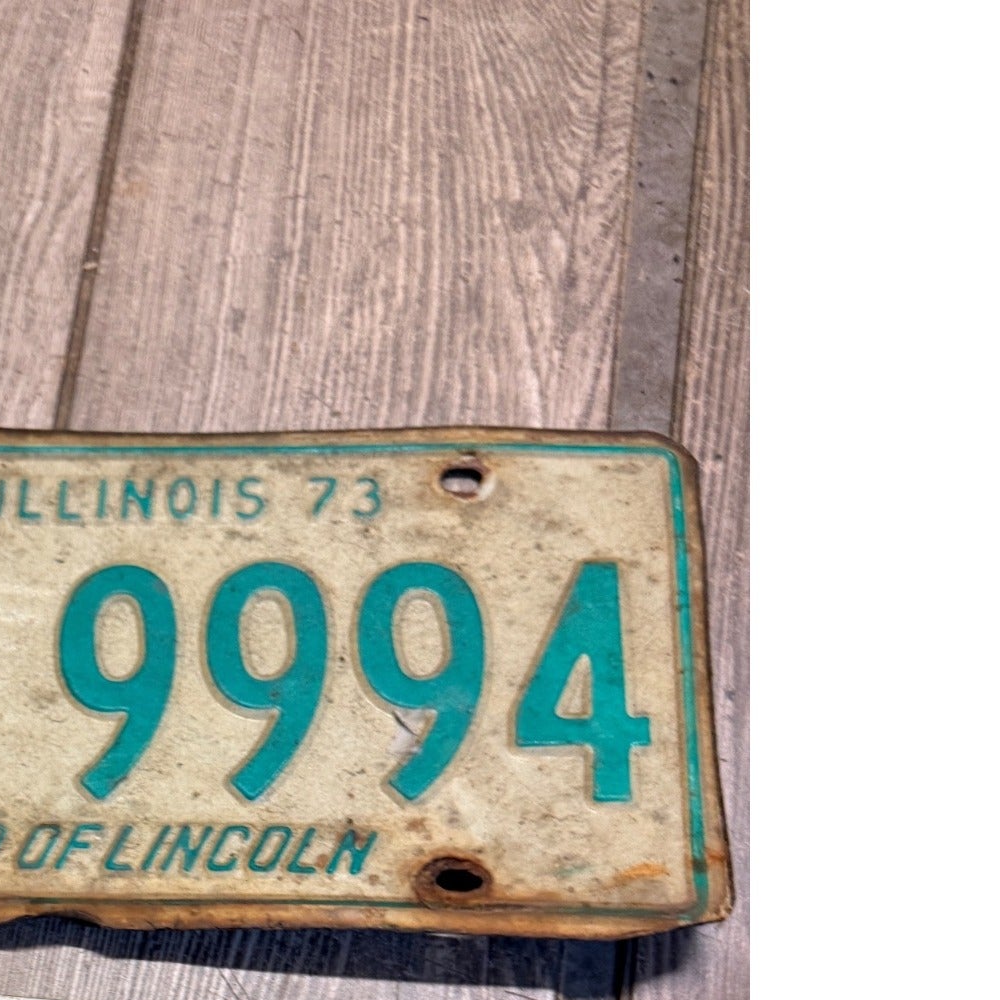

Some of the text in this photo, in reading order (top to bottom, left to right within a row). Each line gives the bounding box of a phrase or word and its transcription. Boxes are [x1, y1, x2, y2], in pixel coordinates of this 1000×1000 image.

[307, 478, 383, 517] 73
[59, 561, 651, 803] 9994
[17, 824, 102, 870] OF
[104, 825, 377, 876] LINCOLN
